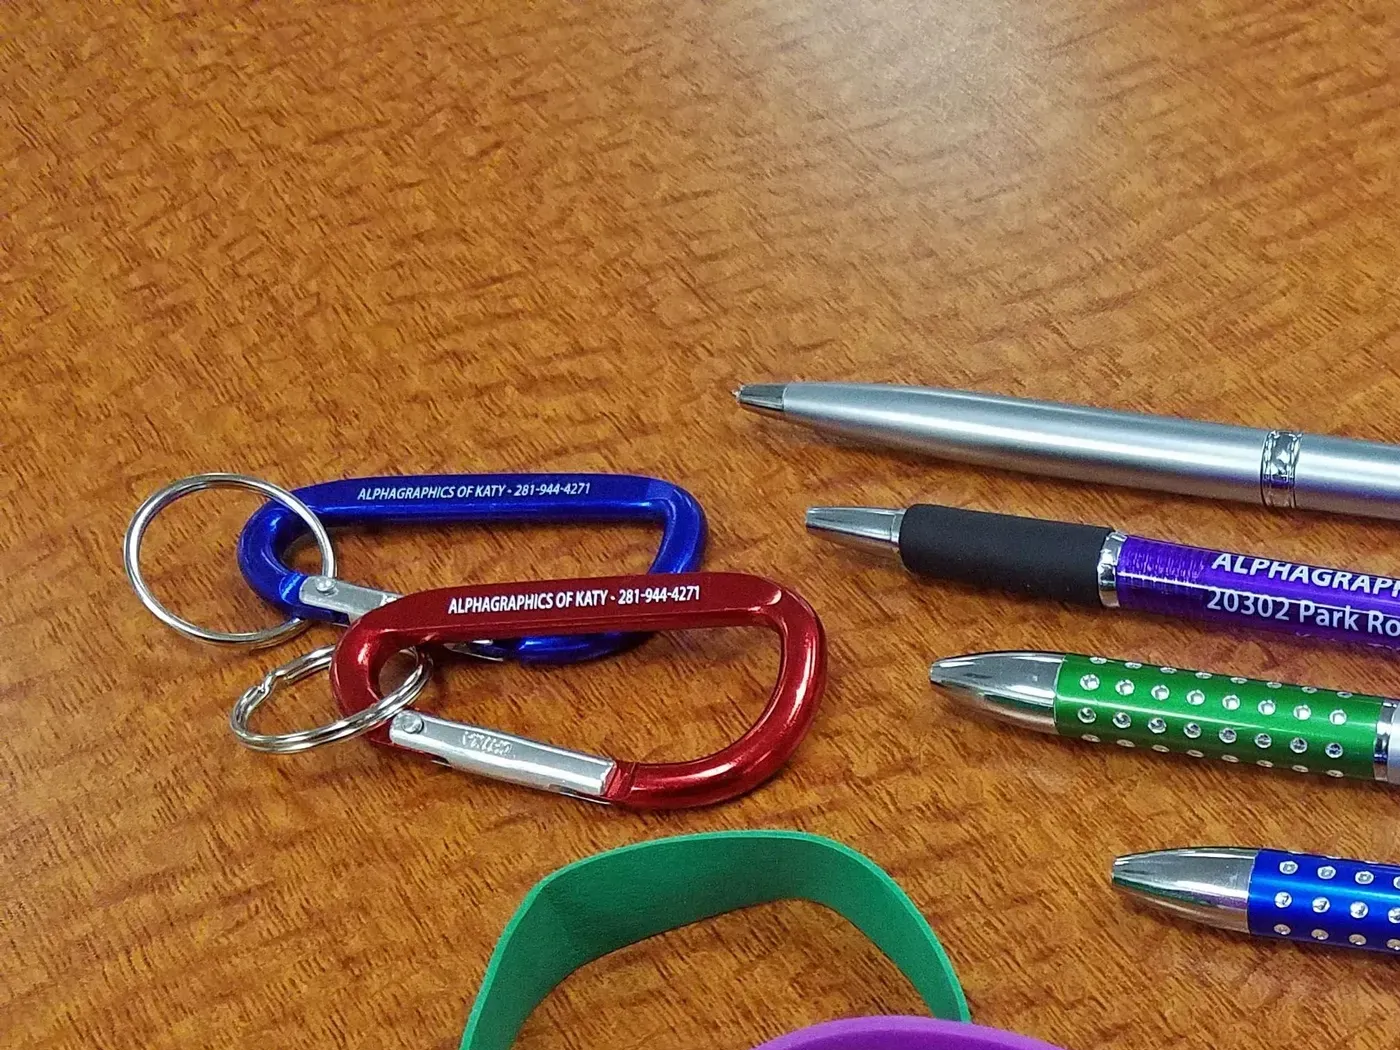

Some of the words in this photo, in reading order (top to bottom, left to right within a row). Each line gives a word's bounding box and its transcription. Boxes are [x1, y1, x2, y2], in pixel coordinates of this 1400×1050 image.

[357, 486, 455, 500] ALPHAGRAPHICS
[457, 485, 474, 497] OF
[475, 484, 506, 497] KATY
[513, 482, 591, 496] 281-944-4271
[448, 593, 553, 615] ALPHAGRAPHICS
[556, 592, 573, 609] OF
[575, 589, 608, 607] KATY
[618, 585, 700, 605] 281-944-4271
[1206, 590, 1290, 621] 20302
[1299, 600, 1359, 631] Park
